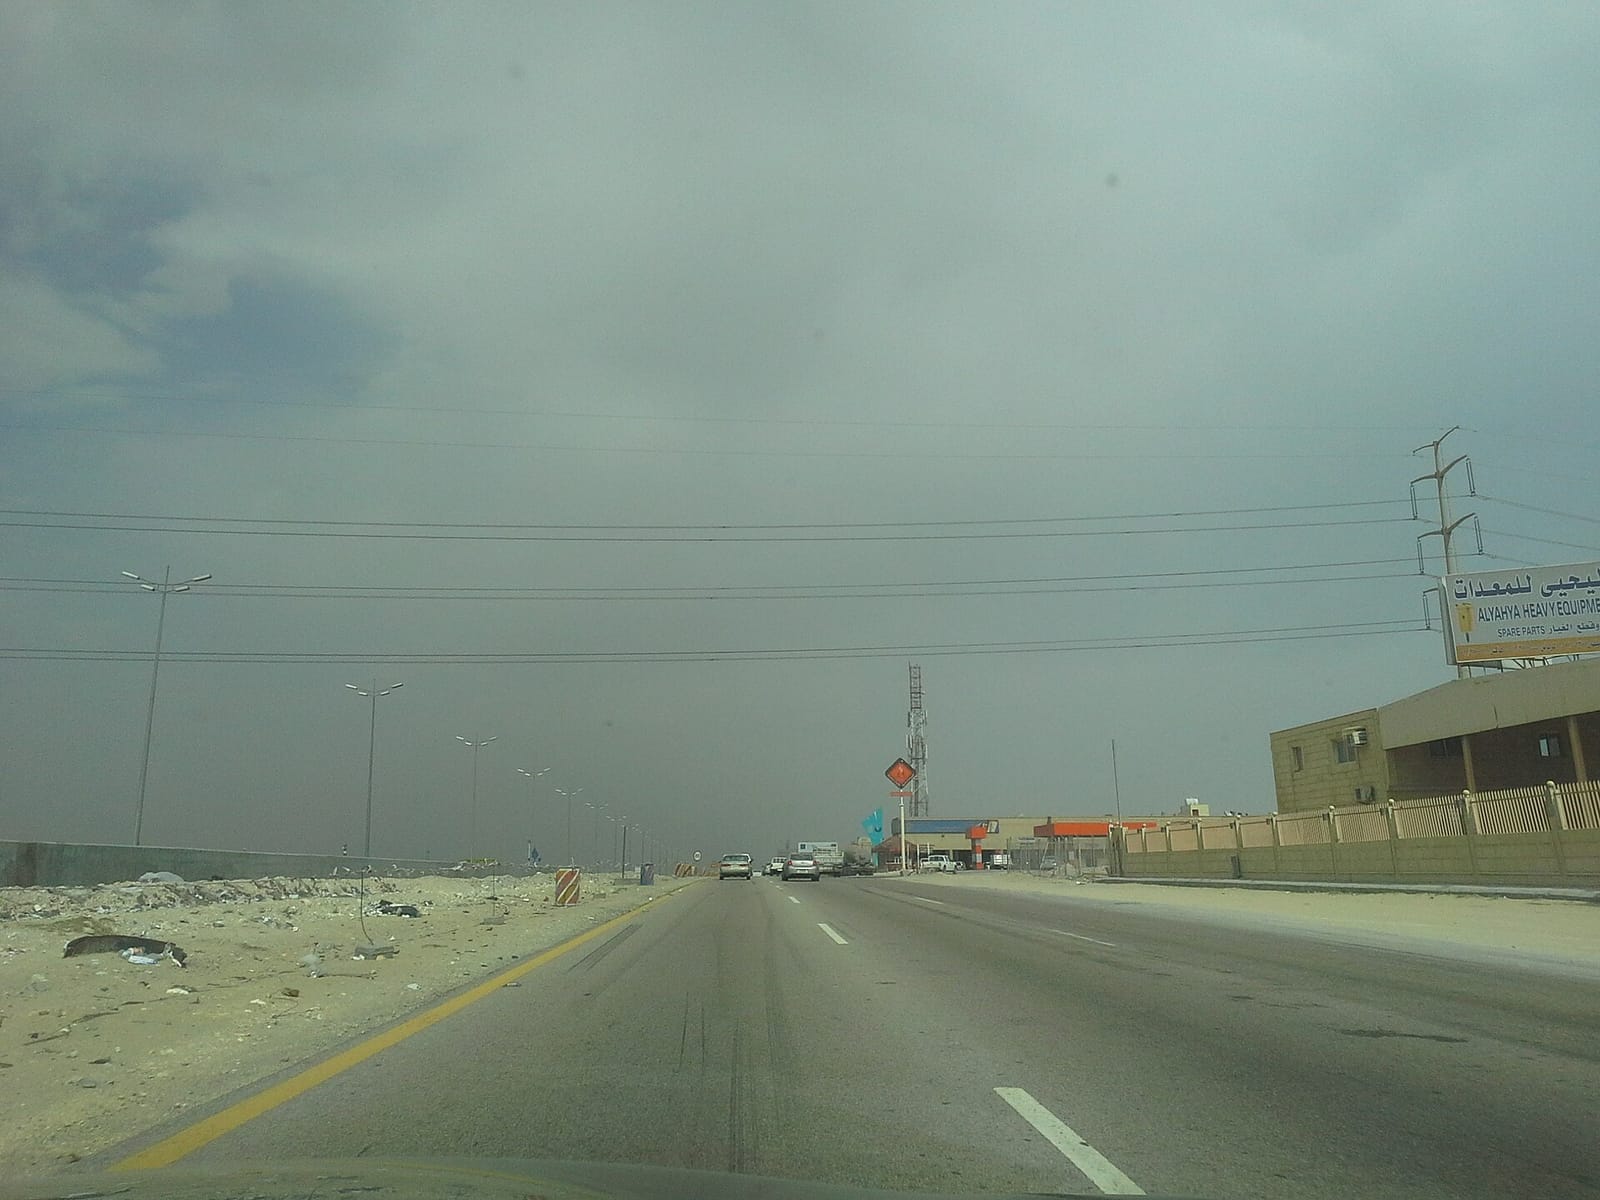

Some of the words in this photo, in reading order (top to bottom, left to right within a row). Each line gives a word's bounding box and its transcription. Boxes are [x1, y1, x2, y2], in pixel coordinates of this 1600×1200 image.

[1455, 574, 1532, 599] للمعدات
[1478, 604, 1521, 622] ALYAHYA
[1524, 601, 1555, 618] HEAVY
[1497, 627, 1521, 638] SPARE
[1522, 625, 1546, 636] PARTS
[1548, 624, 1573, 635] الغيار
